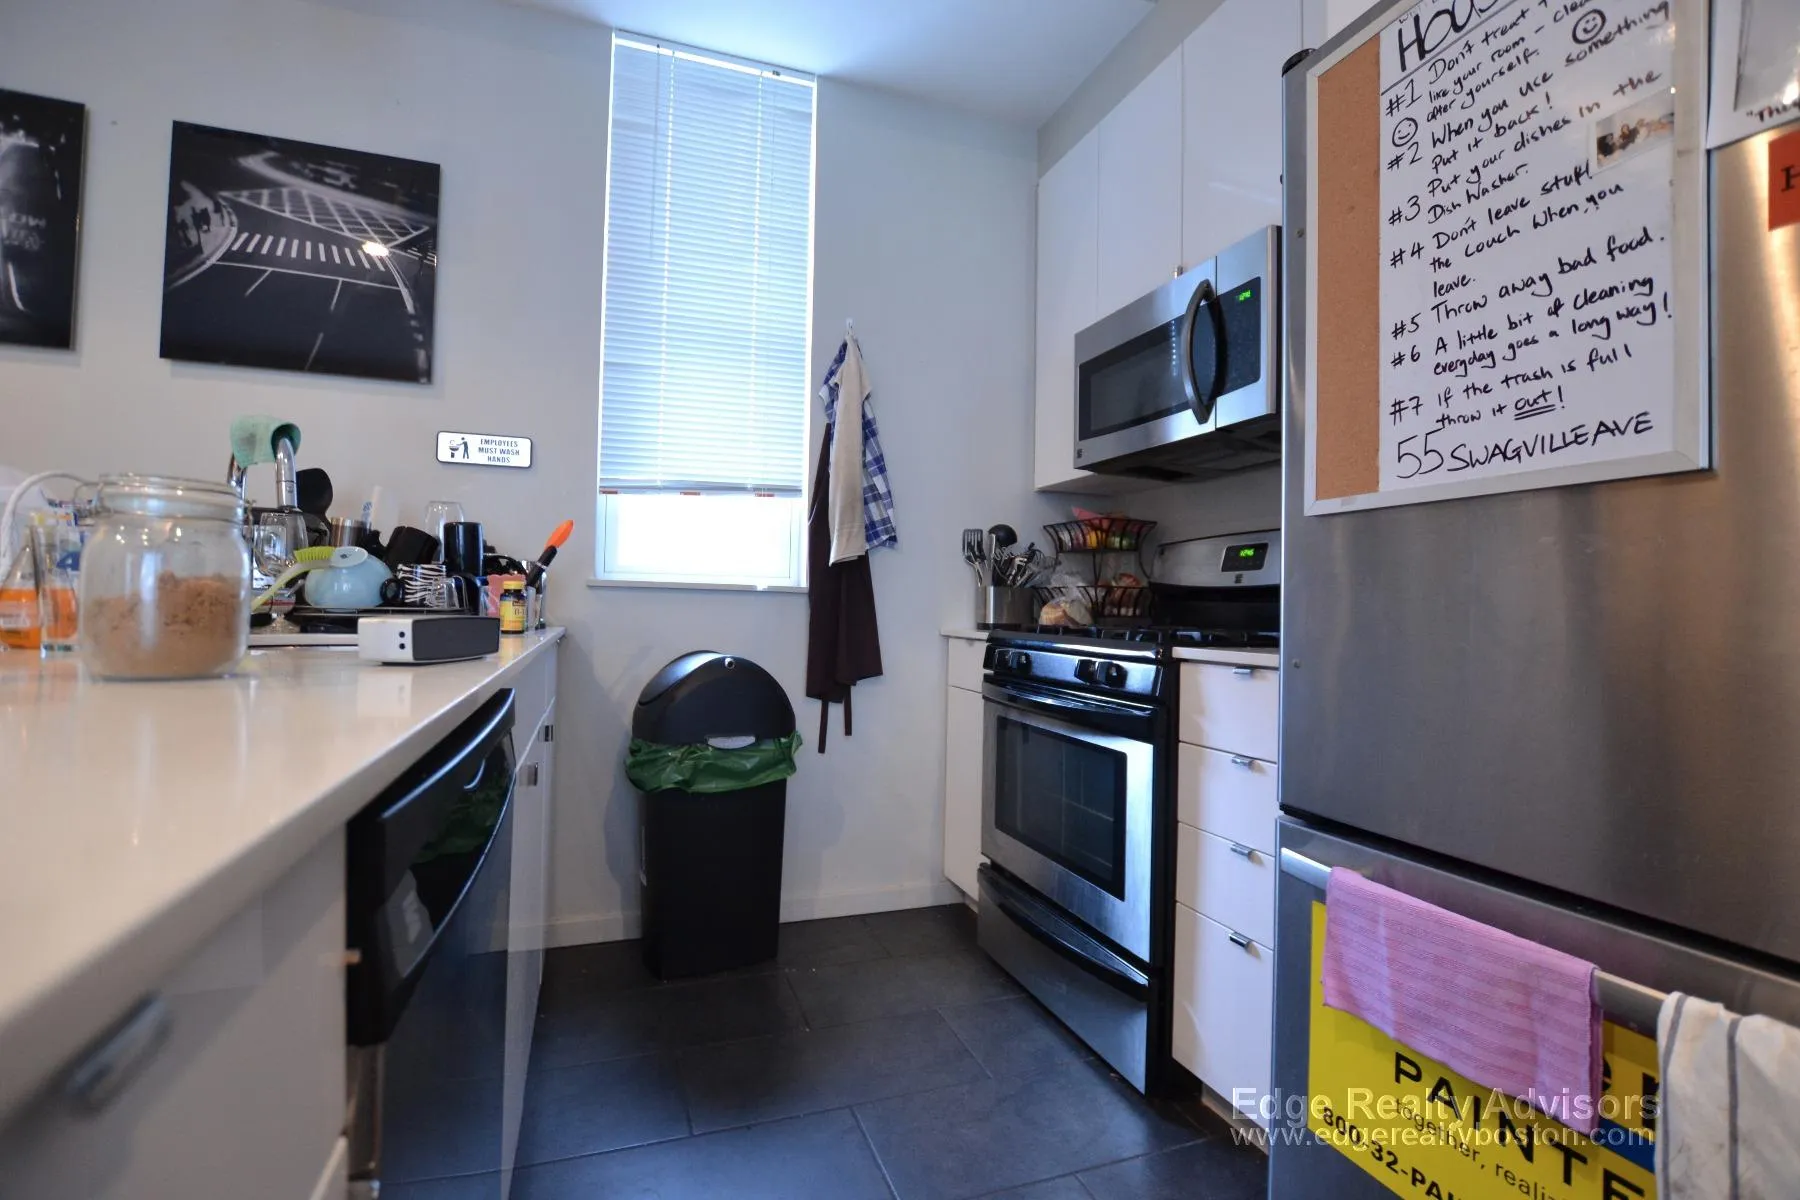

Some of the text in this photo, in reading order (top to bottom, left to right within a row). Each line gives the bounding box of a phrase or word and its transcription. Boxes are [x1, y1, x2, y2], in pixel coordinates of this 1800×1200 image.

[1386, 78, 1422, 117] #1
[1481, 8, 1530, 45] treat
[1387, 0, 1670, 171] #2 When you use something
[1426, 48, 1540, 123] after yourself.
[1452, 62, 1482, 95] your
[1491, 36, 1526, 62] room
[1388, 70, 1662, 226] #3 Put your dishes in the
[1467, 136, 1484, 152] it
[1389, 241, 1425, 269] #4
[1432, 216, 1477, 250] Don't
[1487, 196, 1531, 225] leave
[1427, 203, 1462, 225] Dish
[1429, 256, 1452, 273] the
[1464, 224, 1521, 258] couch
[1391, 312, 1422, 341] #5
[1430, 294, 1488, 324] Throw
[1498, 272, 1553, 298] away
[1557, 247, 1598, 275] bad
[1433, 274, 1476, 298] leave.
[1390, 275, 1655, 369] #6 A little bit of cleaning
[1433, 350, 1497, 378] everyday
[1502, 334, 1540, 361] goes
[1548, 328, 1560, 338] a
[1571, 313, 1611, 340] long
[1388, 396, 1424, 427] #7
[1462, 381, 1494, 399] the
[1500, 366, 1554, 390] trash
[1561, 360, 1577, 375] is
[1586, 343, 1634, 373] full
[480, 438, 518, 447] EMPLOYEES
[1435, 408, 1482, 430] throw
[1491, 402, 1508, 418] it
[478, 446, 520, 456] MUST WASH
[487, 455, 511, 463] HANDS
[1495, 1163, 1556, 1200] reali
